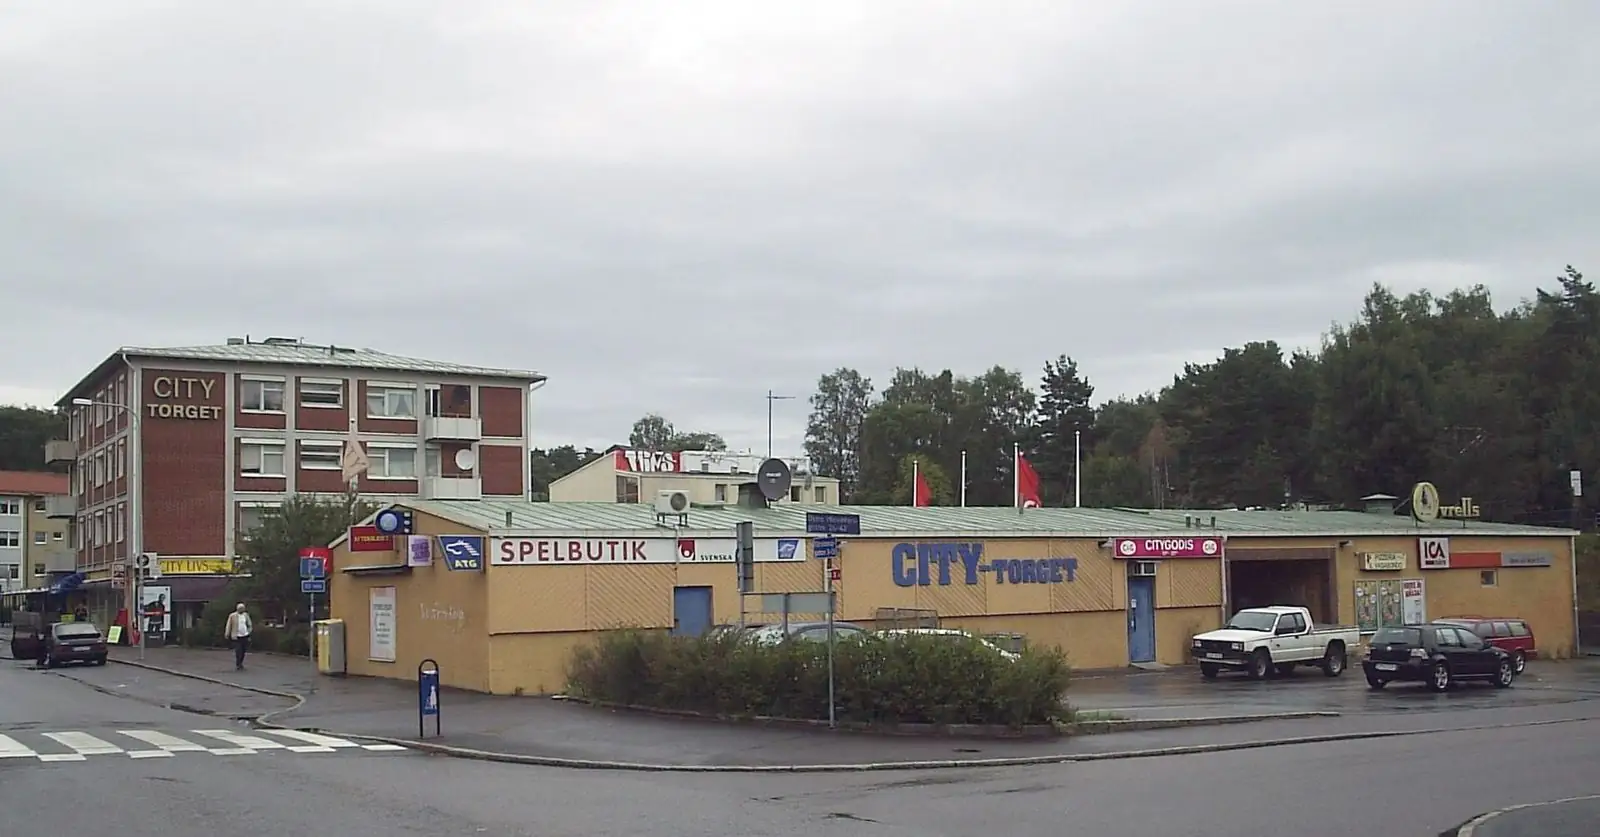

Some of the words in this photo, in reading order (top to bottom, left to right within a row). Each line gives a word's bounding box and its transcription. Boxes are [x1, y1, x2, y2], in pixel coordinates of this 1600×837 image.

[153, 377, 216, 399] CITY
[147, 403, 223, 419] TORGET
[500, 541, 647, 562] SPELBUTIK
[1145, 539, 1194, 551] CITYGODIS
[1424, 541, 1446, 559] ICA
[160, 559, 183, 572] CITY
[186, 559, 209, 571] LIVS
[309, 560, 319, 575] P
[454, 559, 478, 568] ATG
